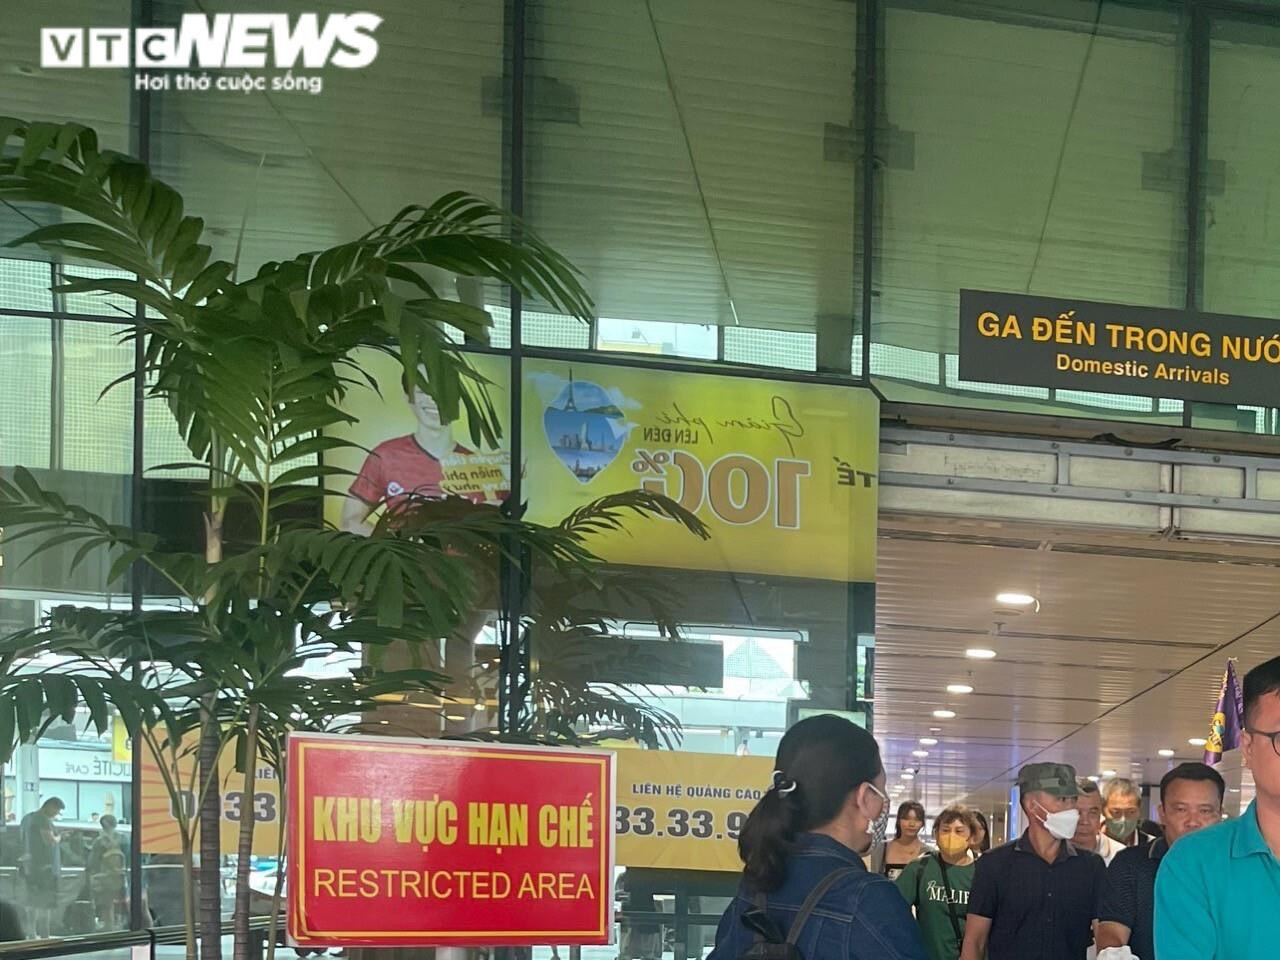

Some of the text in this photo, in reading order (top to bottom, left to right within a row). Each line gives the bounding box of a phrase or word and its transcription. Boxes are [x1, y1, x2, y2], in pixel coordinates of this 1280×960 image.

[977, 311, 1023, 341] GA
[1031, 310, 1096, 347] ĐẾN
[1105, 323, 1212, 358] TRONG
[1056, 353, 1231, 386] Domestic Arrivals
[632, 782, 662, 795] LIÊN
[666, 783, 682, 799] HỆ
[687, 784, 731, 798] QUẢNG
[313, 792, 594, 855] KHU VỰC HẠN CHẾ
[313, 868, 596, 900] RESTRICTED AREA
